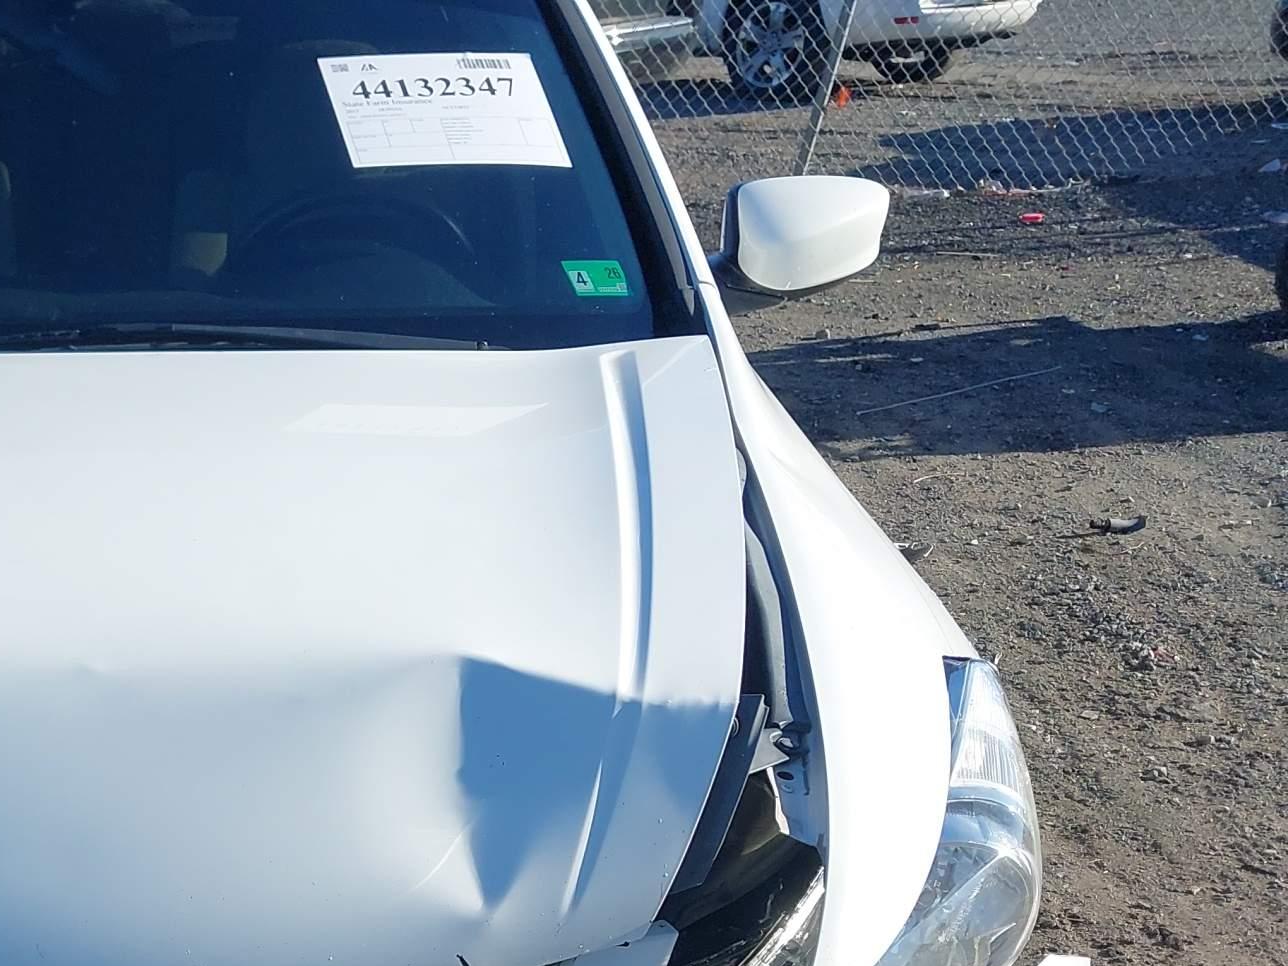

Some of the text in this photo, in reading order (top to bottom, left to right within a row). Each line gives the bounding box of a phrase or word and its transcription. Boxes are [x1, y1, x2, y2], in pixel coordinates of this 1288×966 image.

[352, 77, 513, 99] 44132347
[576, 266, 621, 286] 4 26
